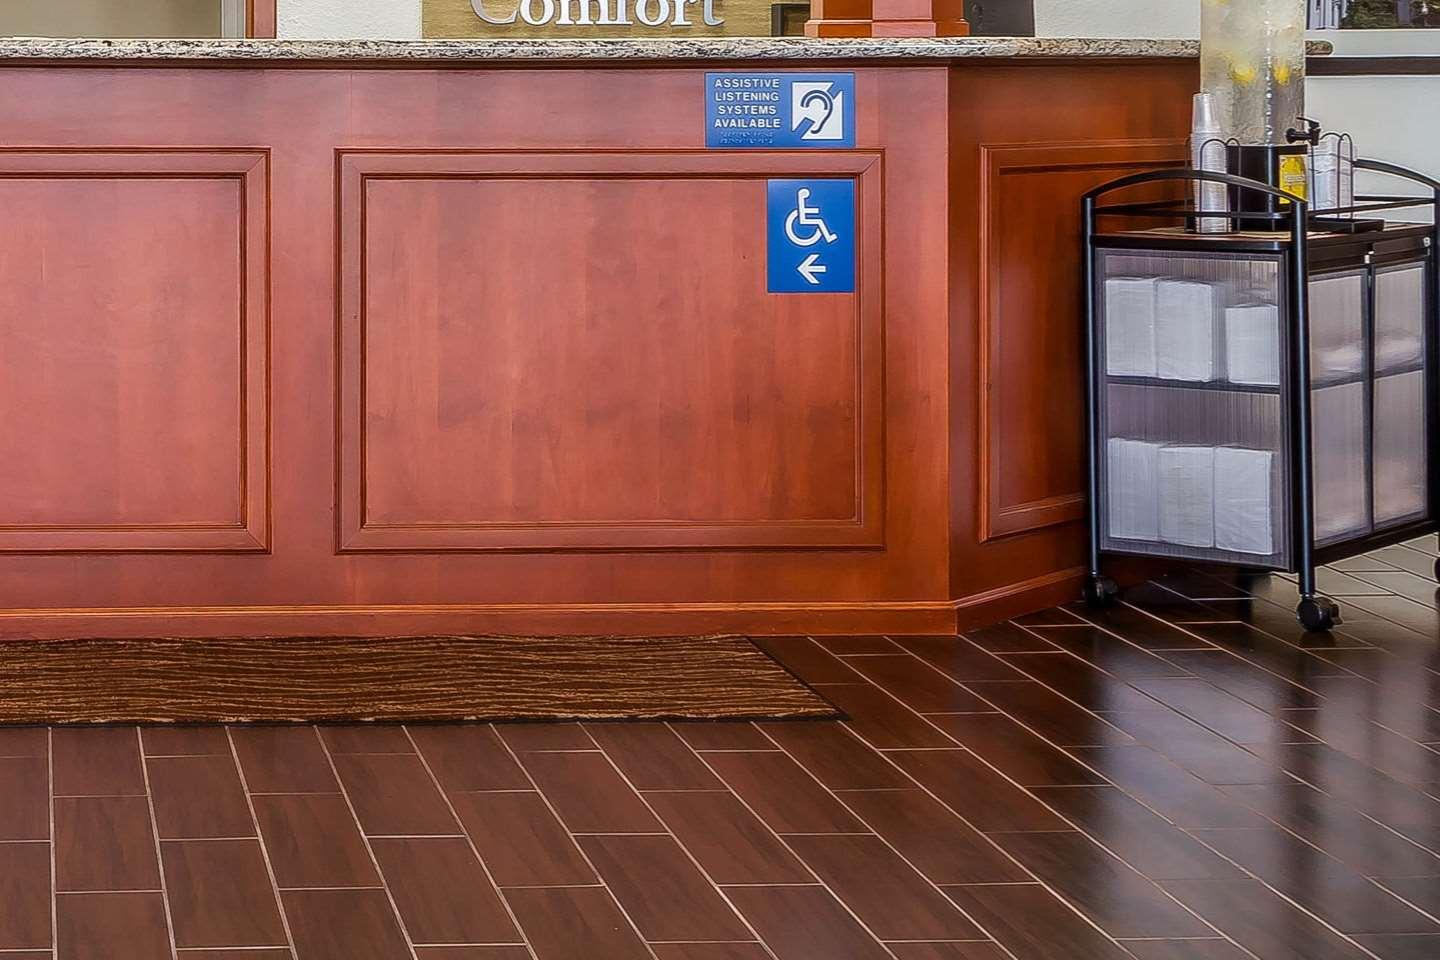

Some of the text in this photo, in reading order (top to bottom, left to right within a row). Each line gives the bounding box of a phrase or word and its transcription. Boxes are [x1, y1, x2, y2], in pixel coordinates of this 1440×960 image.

[714, 79, 780, 88] ASSISTIVE
[715, 92, 779, 101] LISTENING
[718, 105, 777, 115] SYSTEMS
[714, 119, 781, 128] AVAILABLE
